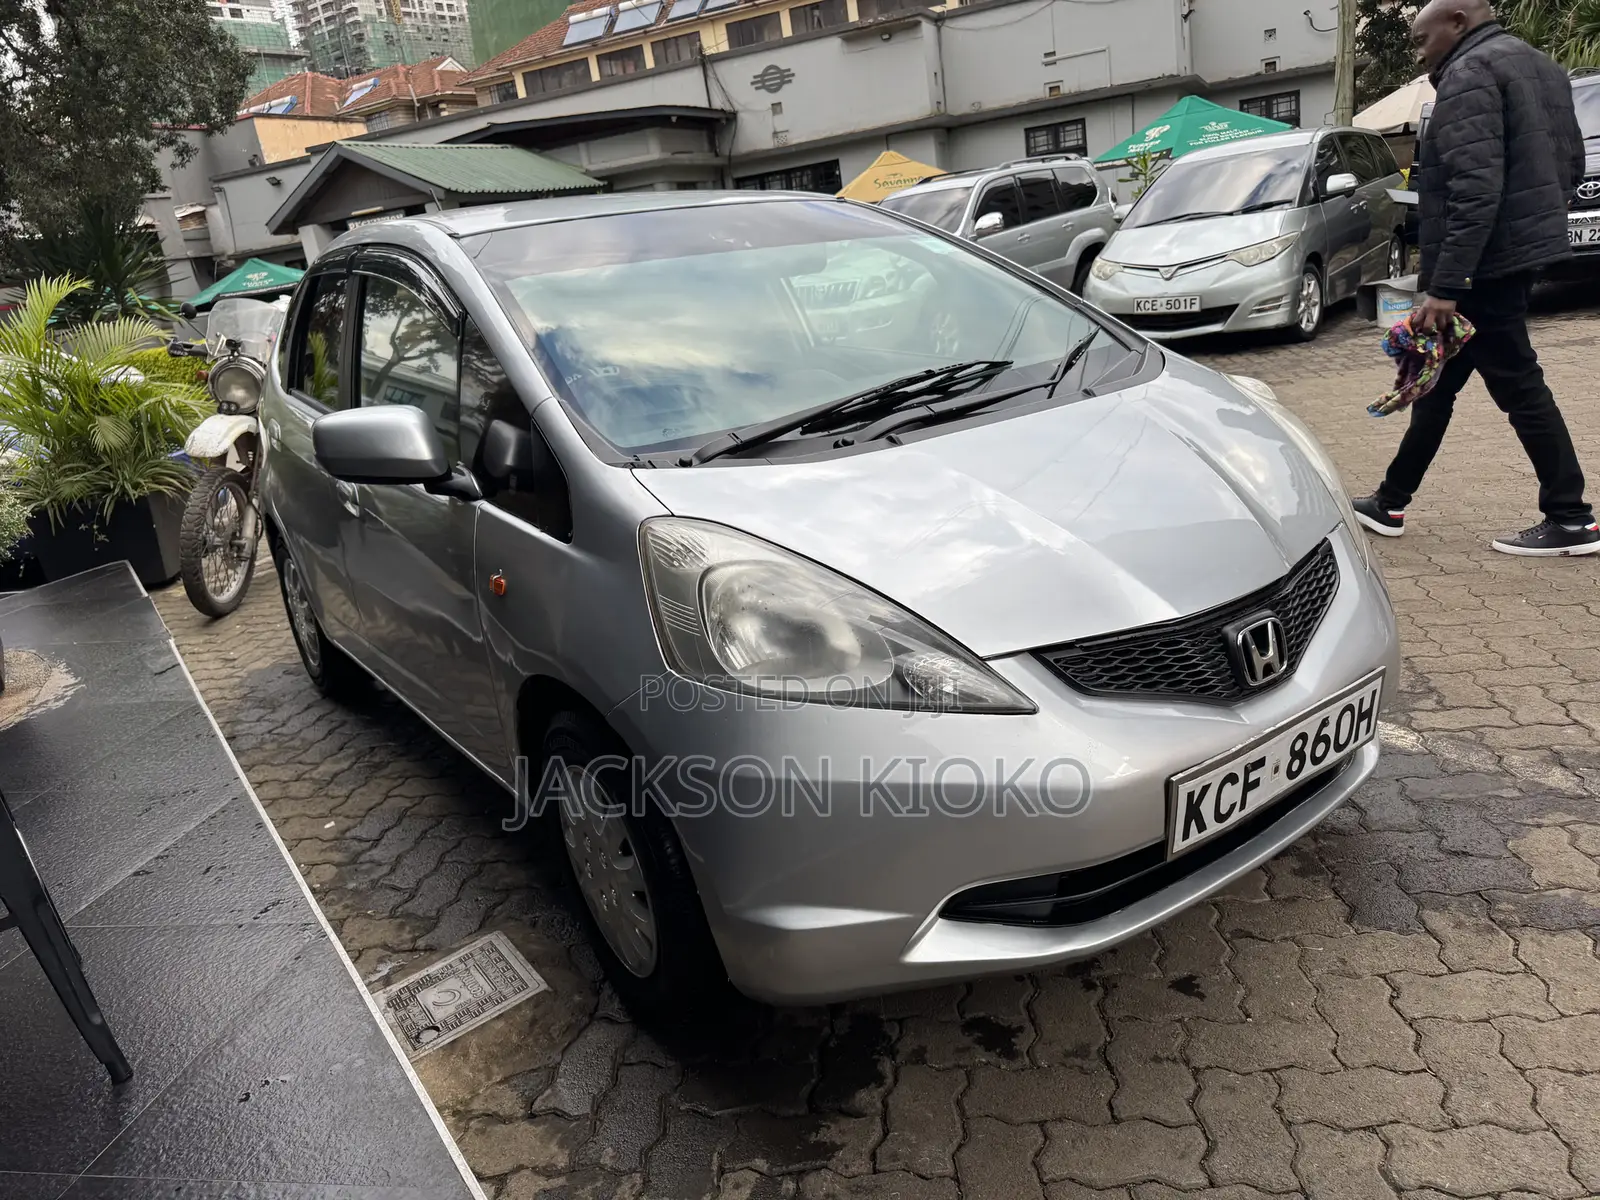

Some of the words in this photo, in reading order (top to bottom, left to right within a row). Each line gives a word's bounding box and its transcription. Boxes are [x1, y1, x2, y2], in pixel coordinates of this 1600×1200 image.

[1136, 299, 1158, 312] KCE
[1165, 297, 1198, 311] 501F
[1182, 755, 1267, 843] KCF
[1285, 688, 1378, 781] 860H
